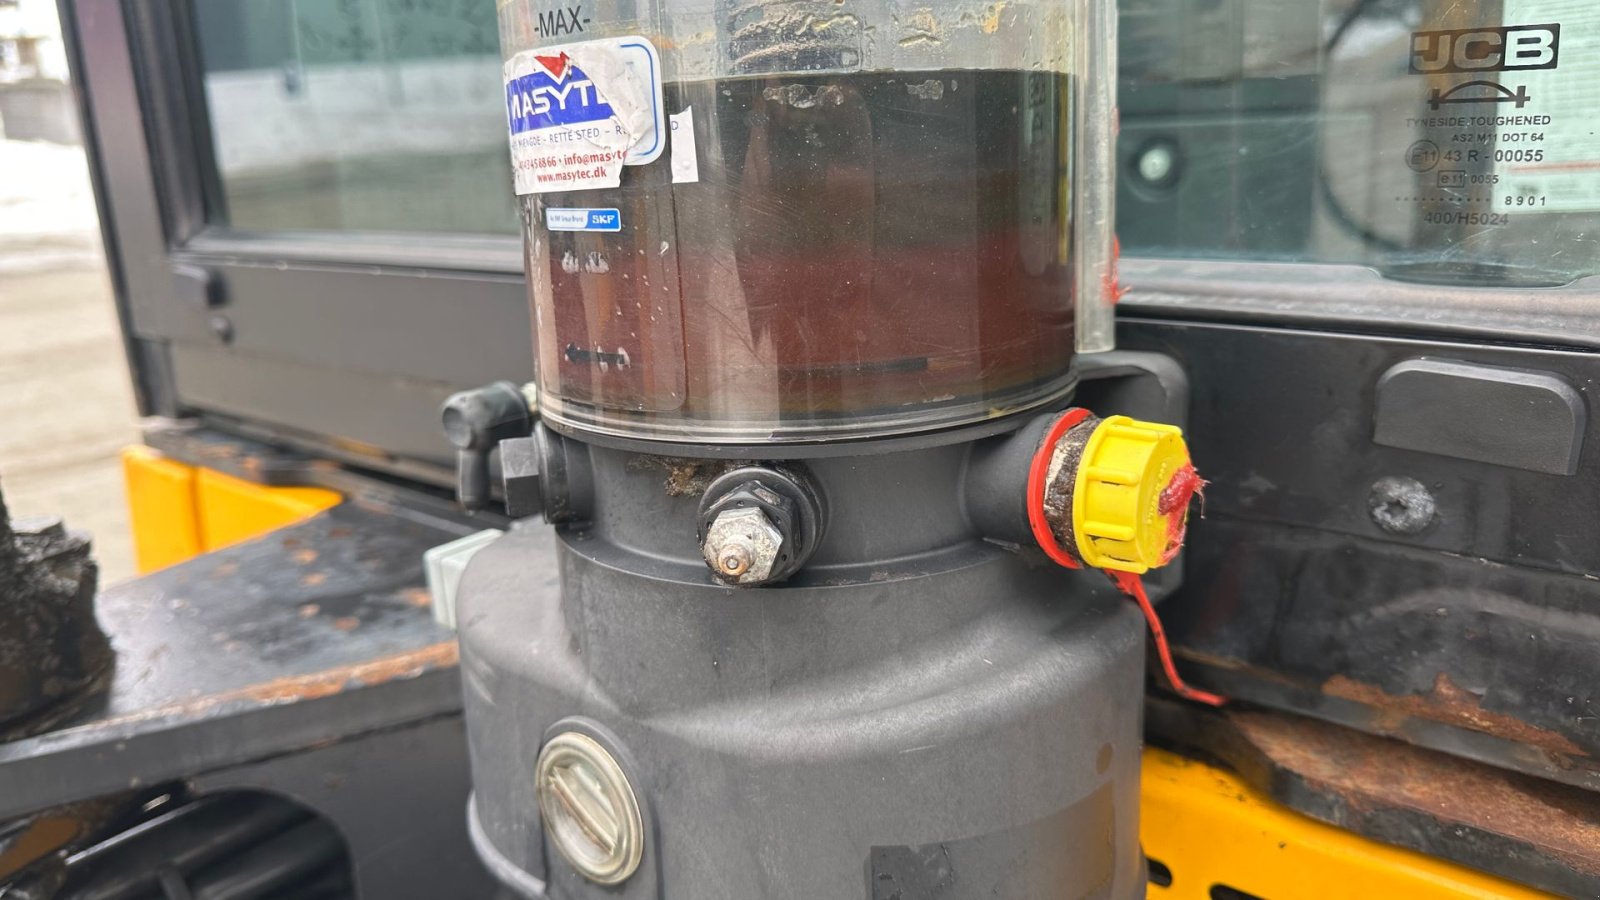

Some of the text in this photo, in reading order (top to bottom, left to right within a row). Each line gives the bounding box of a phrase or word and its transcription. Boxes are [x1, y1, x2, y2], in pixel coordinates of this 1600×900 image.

[1411, 28, 1554, 71] JCB
[1405, 115, 1551, 127] TYNESIDE TOUGHENED
[550, 130, 573, 143] RETTE
[576, 127, 600, 140] STED
[1452, 133, 1473, 143] AS2
[1502, 133, 1528, 142] DOT
[1531, 132, 1544, 141] 64
[1444, 152, 1462, 162] 43
[1467, 151, 1479, 162] R
[1494, 150, 1543, 162] 00055
[537, 167, 607, 183] www.masytec.dk
[1470, 174, 1499, 184] 0055
[592, 215, 615, 224] SKF
[1424, 212, 1509, 225] 400/H5024
